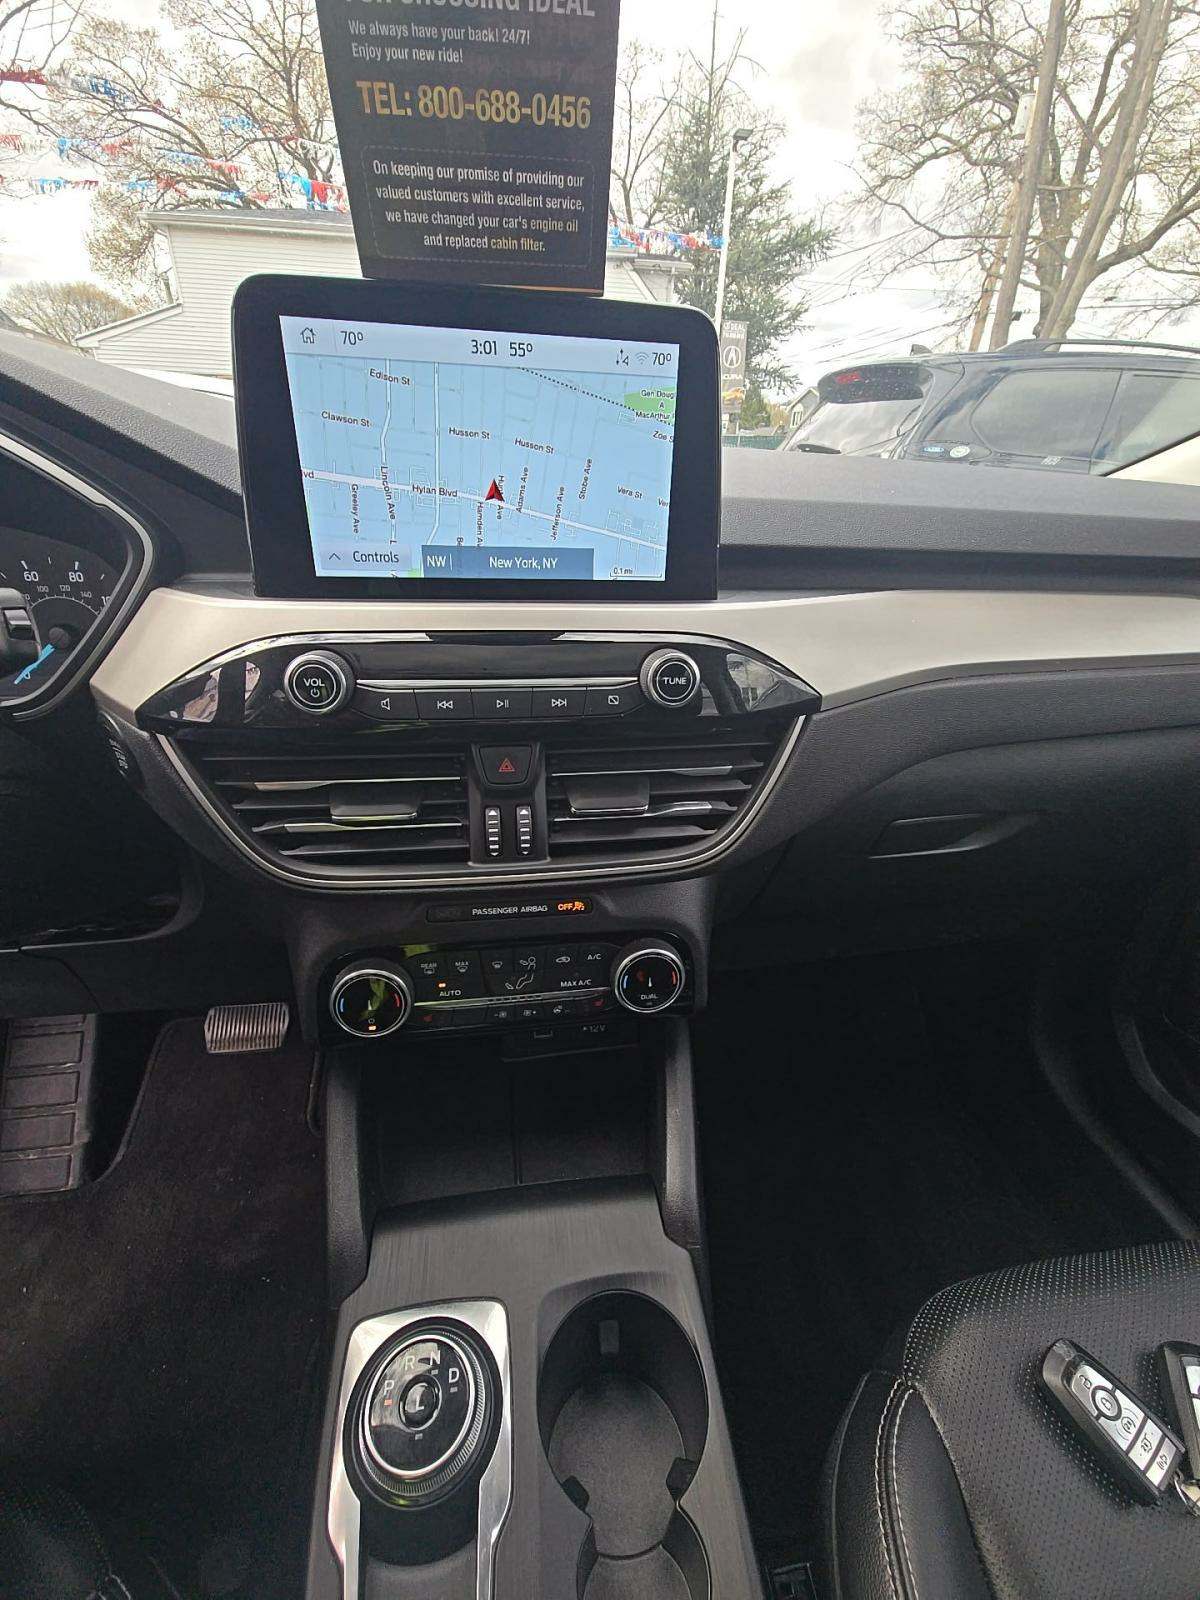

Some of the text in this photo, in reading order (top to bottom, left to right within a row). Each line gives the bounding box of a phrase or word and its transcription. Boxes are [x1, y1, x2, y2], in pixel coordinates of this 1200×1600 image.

[348, 19, 530, 45] We always have your back! 24/7!
[351, 43, 464, 64] Enjoy your new ride!
[356, 80, 591, 129] TEL: 800-688-0456
[373, 159, 585, 188] On keeping our promise of providing our
[375, 185, 586, 213] valued customers with excellent service,
[385, 209, 579, 235] we have changed your car's engine oil
[423, 233, 546, 252] and replaced cabin filter.
[470, 339, 498, 356] 3:01
[369, 368, 411, 386] Edison St
[641, 389, 655, 397] Gen
[321, 411, 370, 428] Clawson St
[448, 427, 491, 439] Husson St
[514, 438, 555, 455] Husson St
[583, 458, 593, 475] Ave
[380, 465, 396, 520] Lincoln Ave
[412, 484, 458, 498] Hylan Blvd
[515, 466, 529, 514] Adams Ave
[634, 491, 643, 499] St
[351, 483, 359, 517] Greeley
[550, 486, 565, 541] Jefferson Ave
[352, 550, 399, 564] Controls
[426, 555, 446, 567] NW
[489, 556, 558, 570] New York, NY
[23, 571, 84, 582] 60 80
[613, 567, 623, 575] 0.1
[80, 591, 92, 599] 140
[303, 677, 326, 687] VOL
[663, 677, 688, 685] TUNE
[520, 905, 548, 913] AIRBAG
[557, 903, 573, 911] OFF
[587, 953, 602, 961] A/C
[404, 1355, 415, 1371] R
[429, 1349, 441, 1366] N
[448, 1367, 460, 1384] D
[383, 1379, 395, 1396] P
[414, 1395, 425, 1412] L
